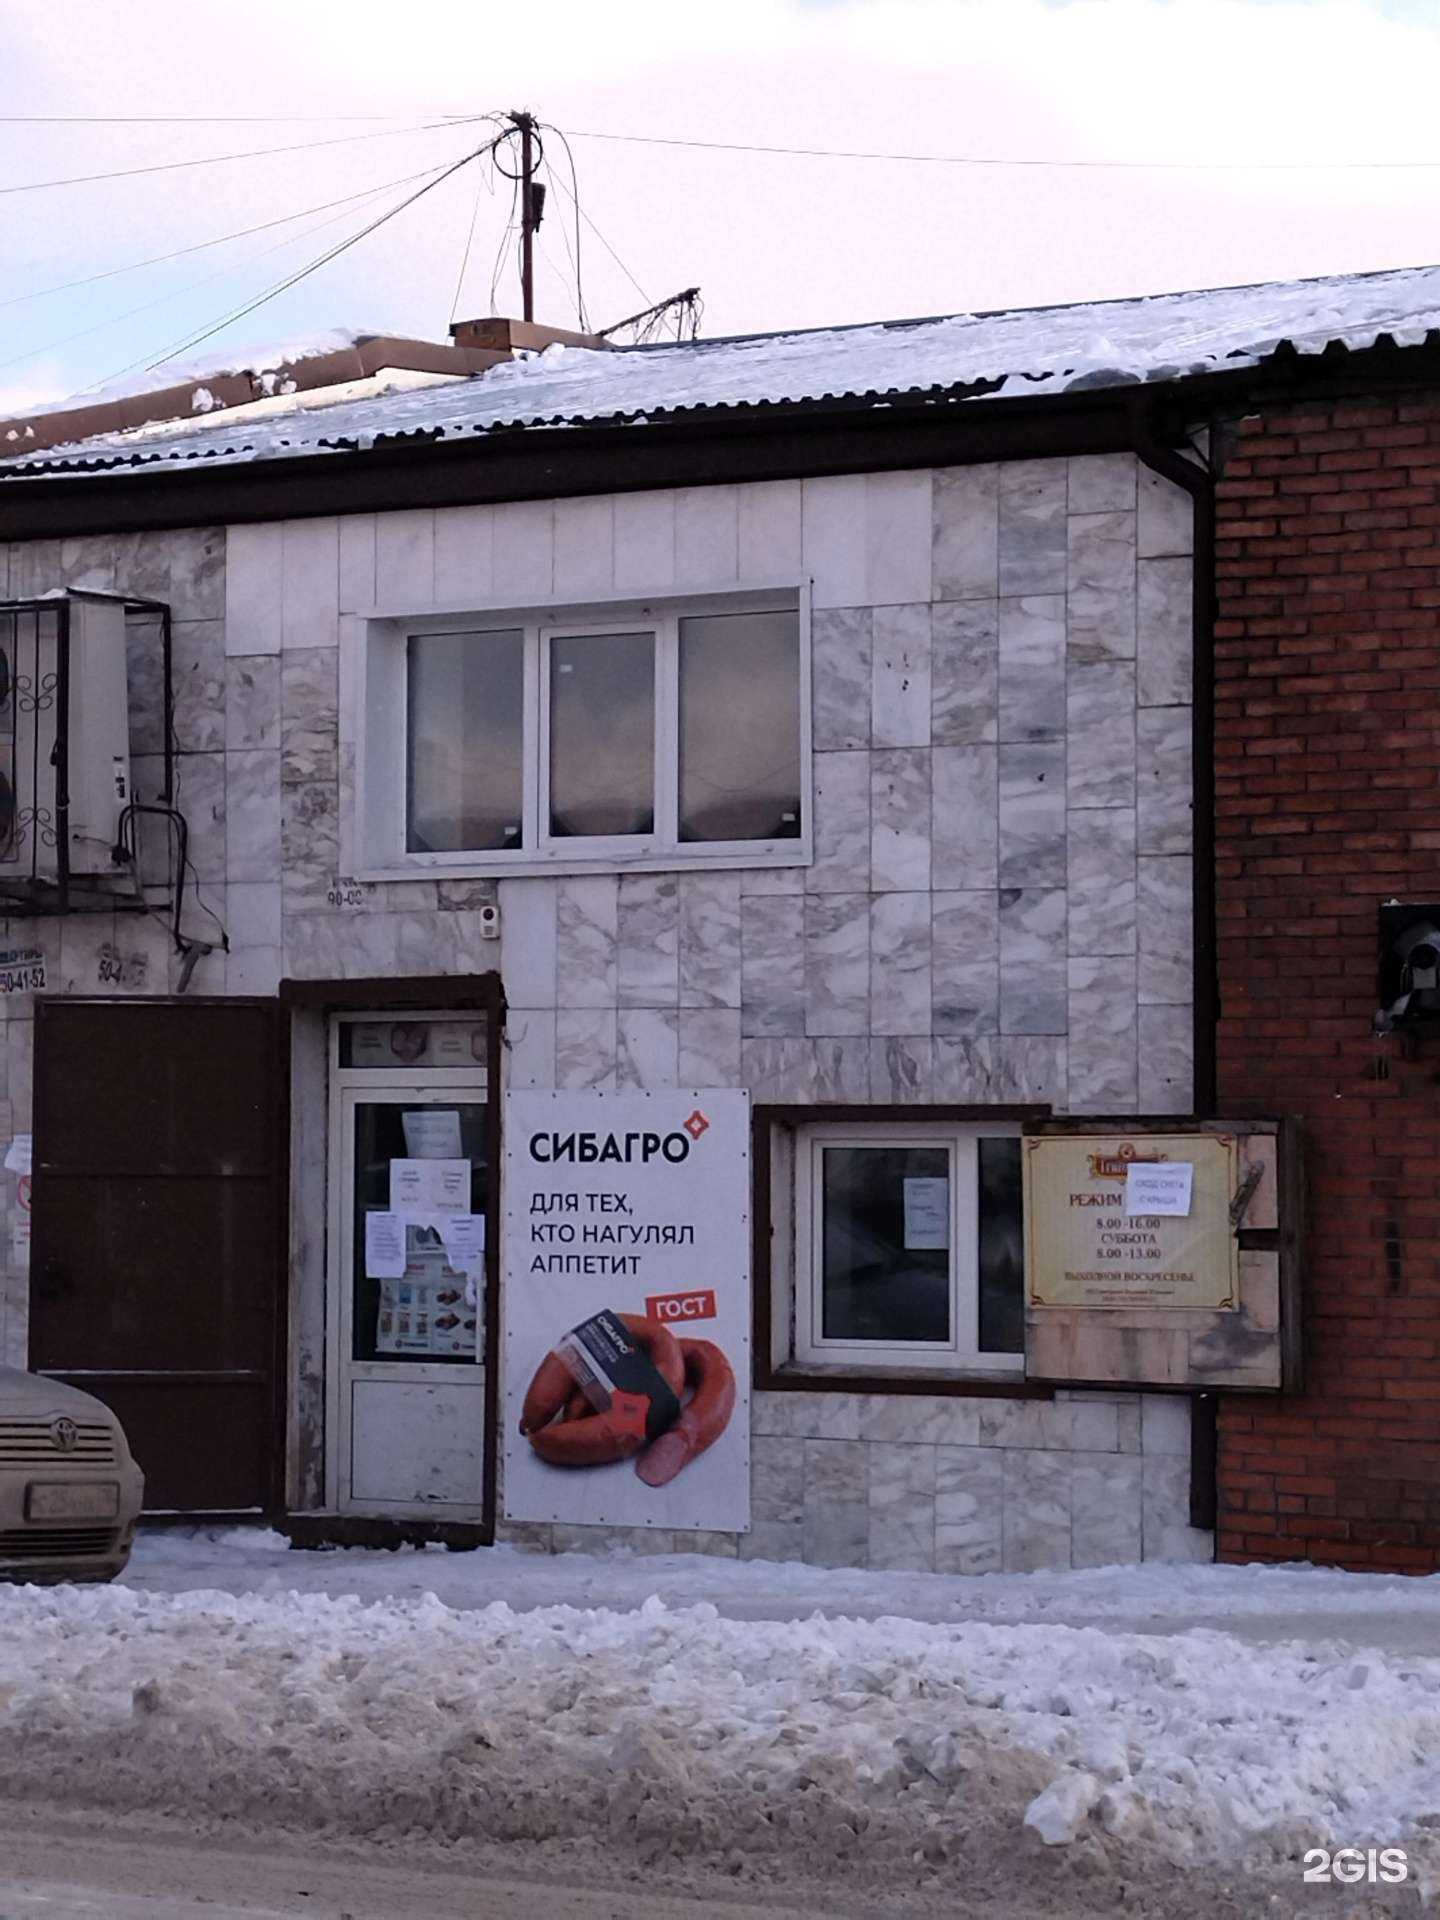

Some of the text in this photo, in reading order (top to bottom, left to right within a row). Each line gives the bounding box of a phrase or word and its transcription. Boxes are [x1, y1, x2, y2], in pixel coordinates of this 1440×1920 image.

[529, 1132, 690, 1163] СИБАГРО
[530, 1194, 633, 1215] ДЛЯ ТЕХ,
[1069, 1193, 1122, 1207] РЕЖИМ
[531, 1224, 694, 1244] КТО НАГУЛЯЛ
[1101, 1233, 1156, 1244] СУББОТА
[530, 1255, 641, 1275] АППЕТИТ
[656, 1297, 706, 1318] ГОСТ
